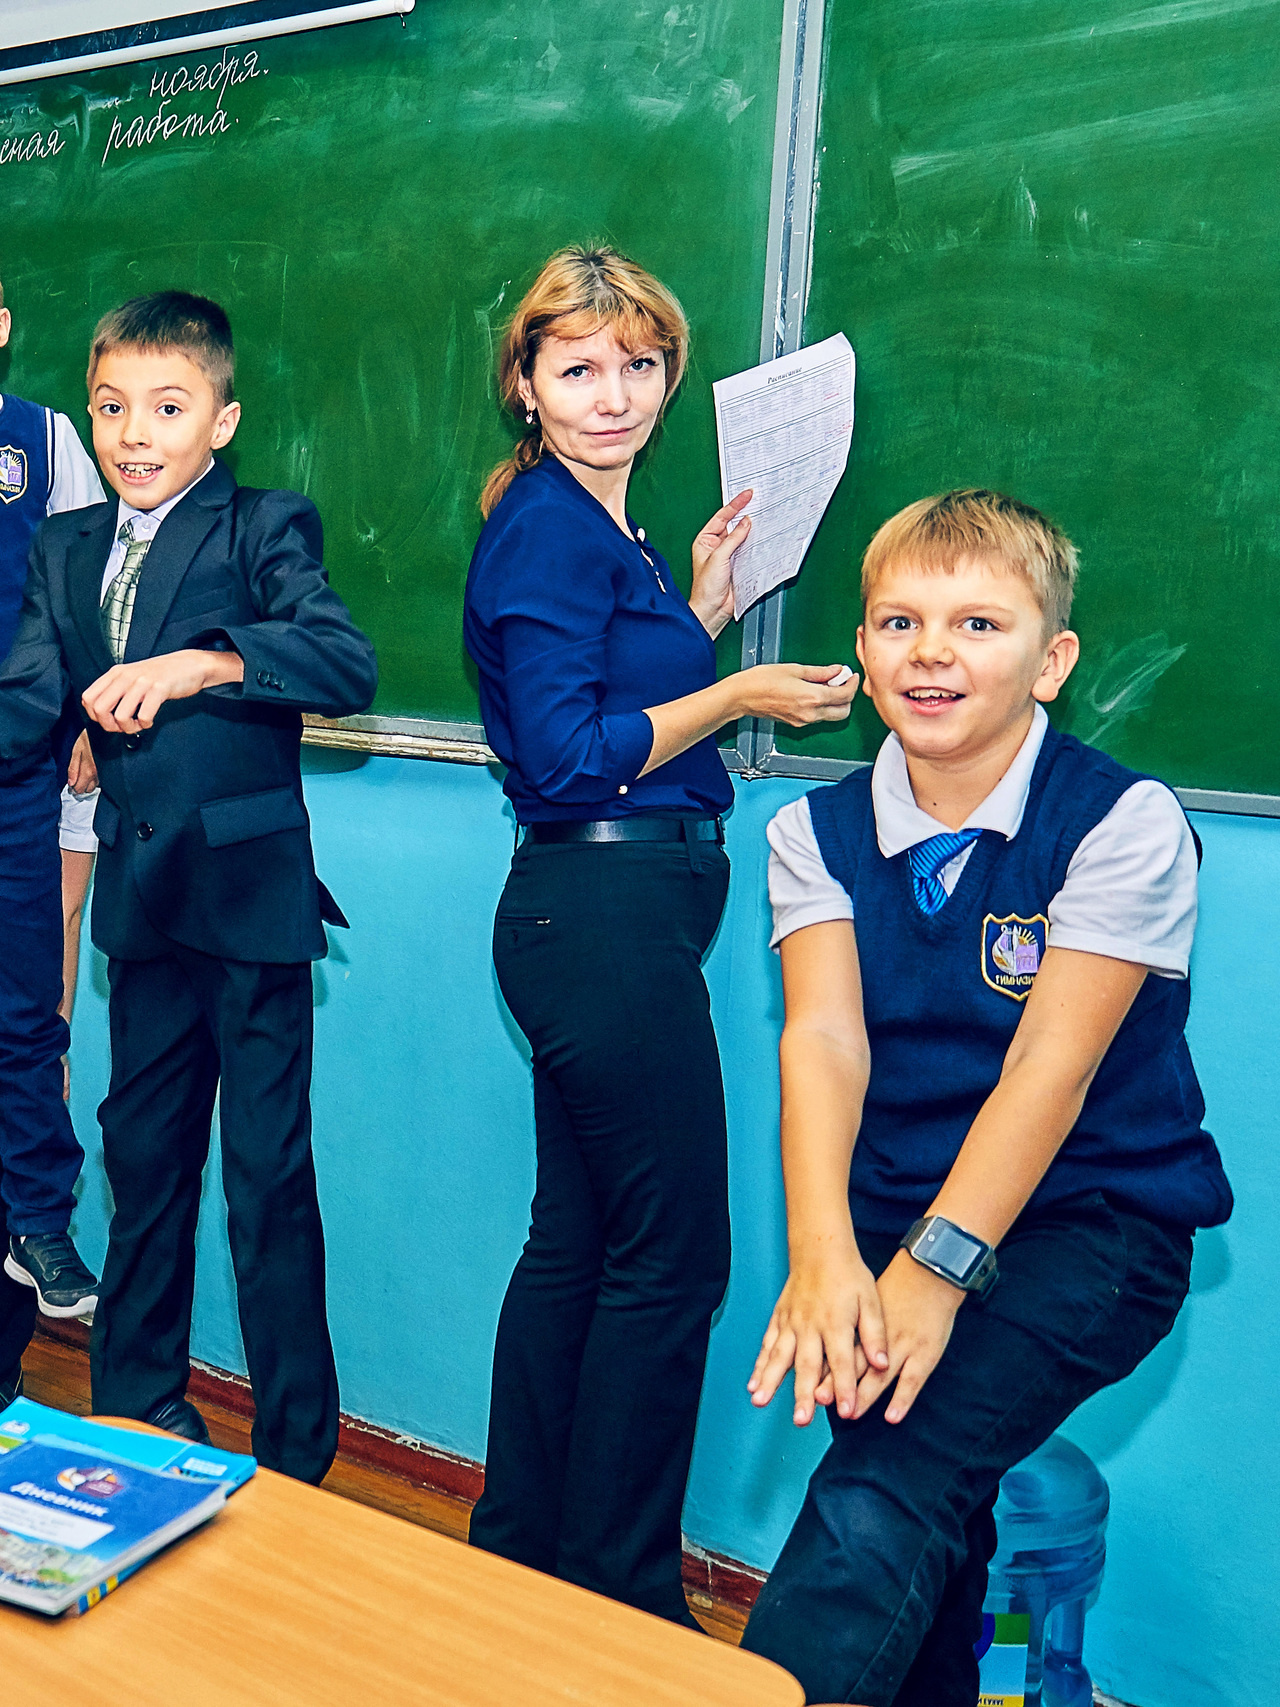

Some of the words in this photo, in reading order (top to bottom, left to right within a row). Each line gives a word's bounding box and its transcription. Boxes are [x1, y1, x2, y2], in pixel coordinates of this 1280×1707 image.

[149, 45, 269, 108] ноября.
[995, 974, 1035, 986] ГИМНАЗИ
[9, 1481, 109, 1517] Дневник
